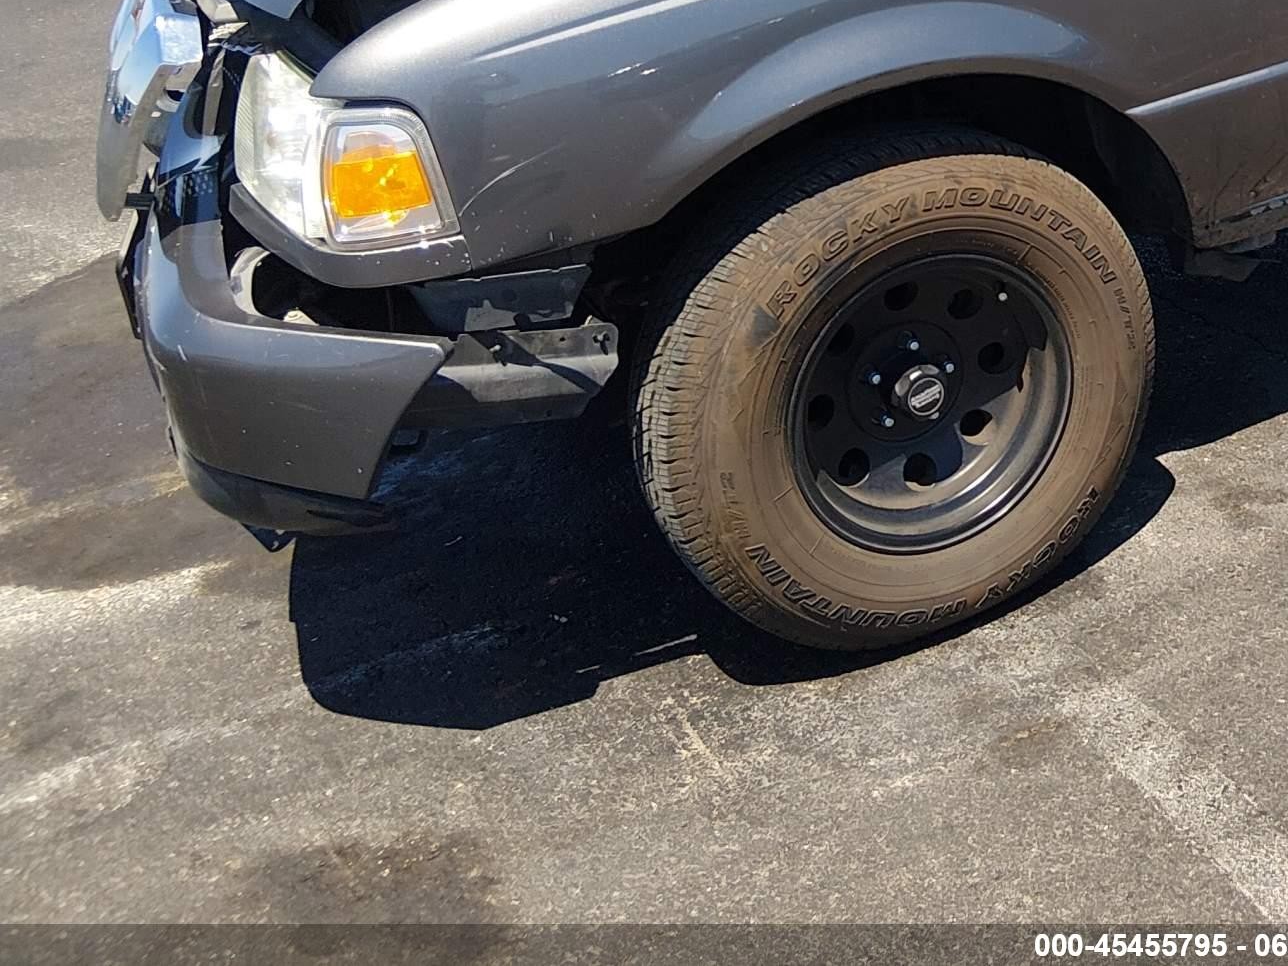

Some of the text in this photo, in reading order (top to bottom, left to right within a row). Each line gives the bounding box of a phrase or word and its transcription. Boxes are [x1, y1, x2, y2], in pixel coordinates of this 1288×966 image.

[764, 197, 911, 321] ROCKY
[920, 186, 1117, 286] MOUNTAIN
[745, 542, 968, 627] MOUNTAIN
